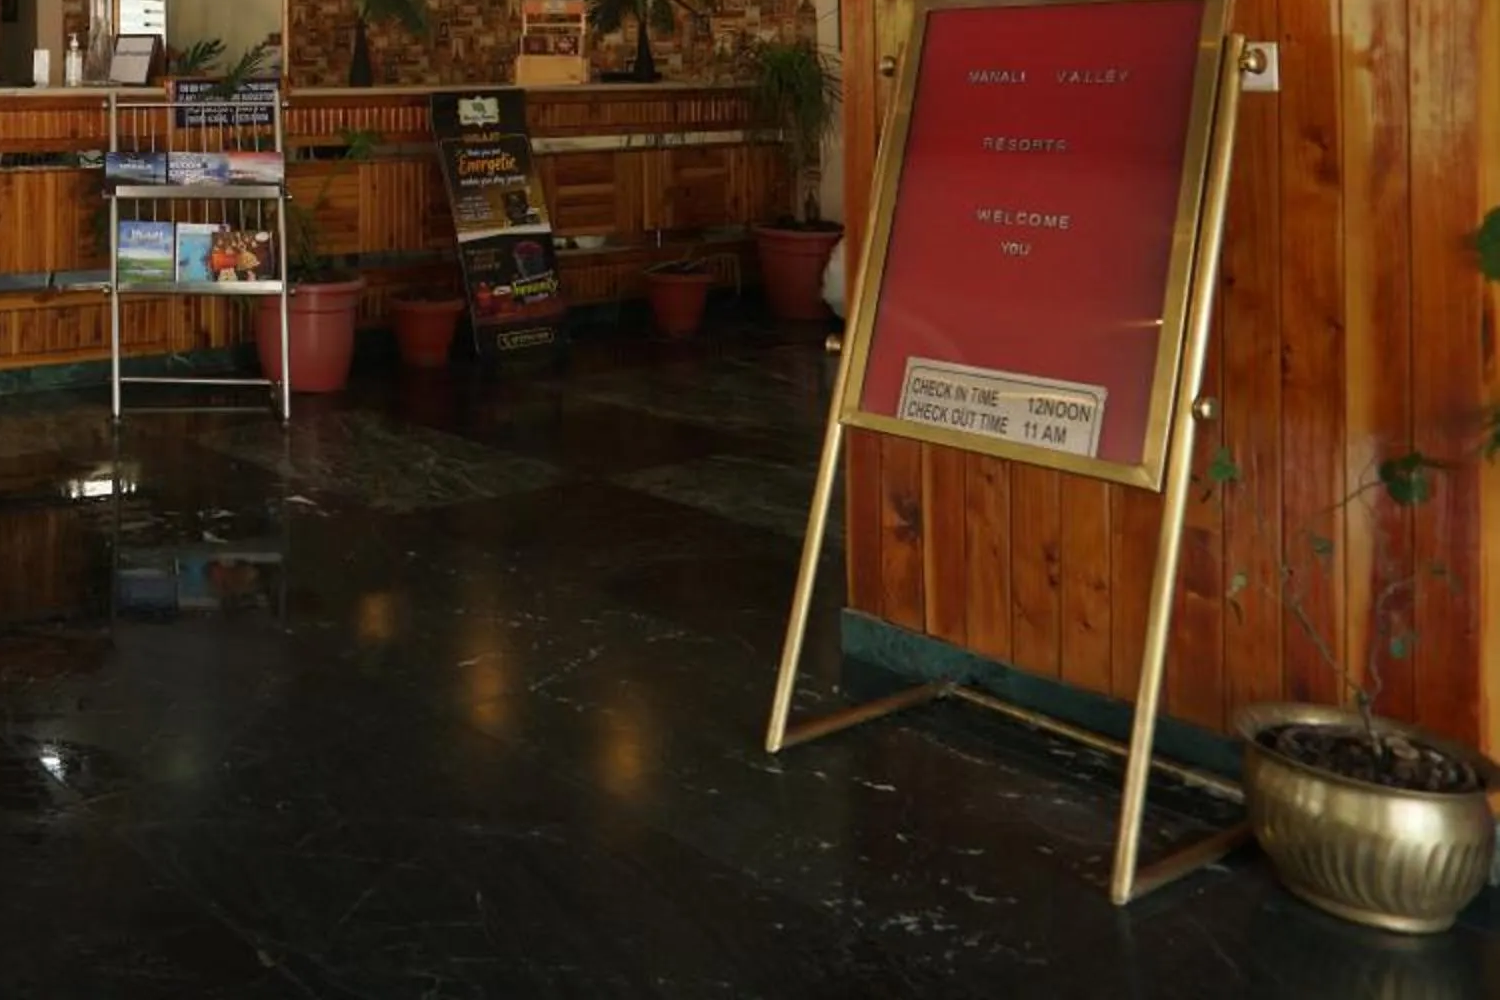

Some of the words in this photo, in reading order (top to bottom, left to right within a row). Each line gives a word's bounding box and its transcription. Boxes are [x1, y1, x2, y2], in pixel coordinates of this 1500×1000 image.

[1057, 69, 1128, 83] VALLEY
[977, 208, 1070, 229] WELCOME
[1001, 242, 1031, 255] YOU
[912, 377, 953, 399] CHECK
[955, 386, 967, 400] IN
[972, 387, 999, 407] TIME
[1027, 397, 1092, 423] 12NOON
[907, 401, 948, 424] CHECK
[952, 407, 976, 429] OUT
[980, 413, 1010, 435] TIME
[1023, 421, 1037, 438] 11
[1041, 426, 1067, 444] AM
